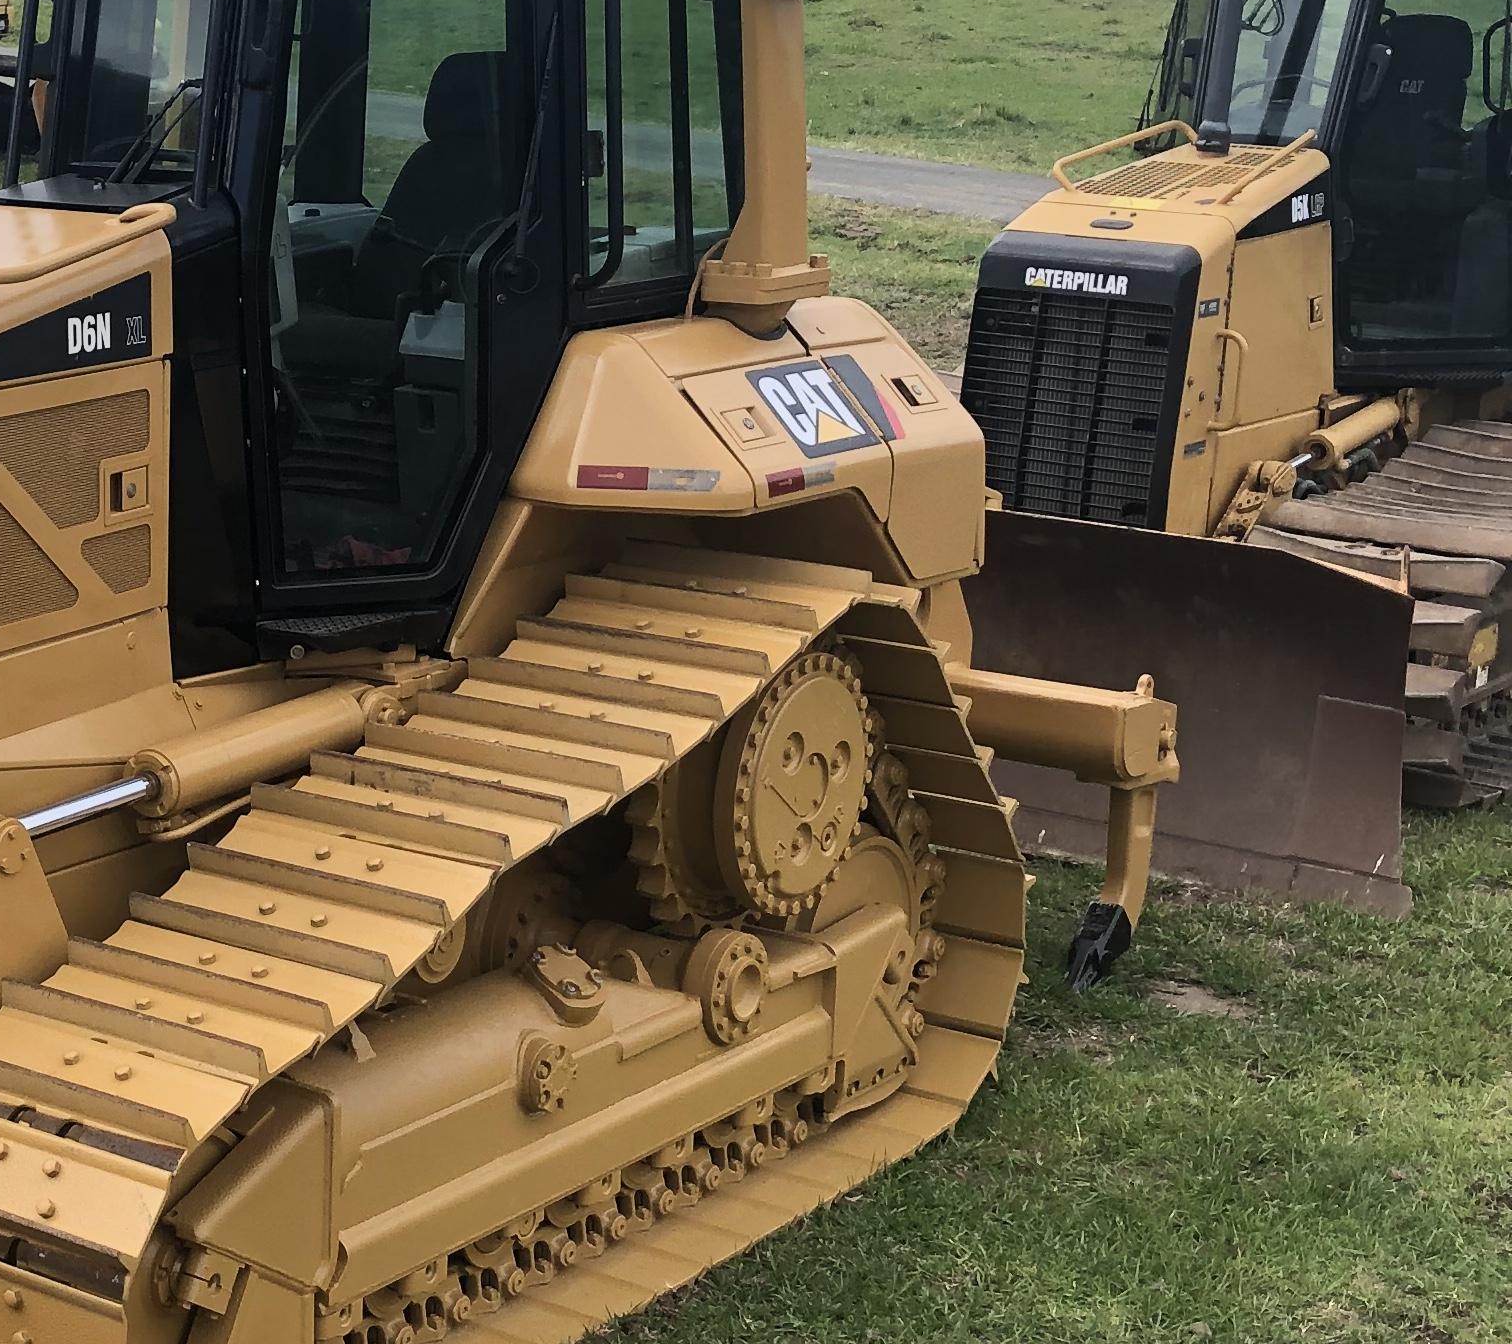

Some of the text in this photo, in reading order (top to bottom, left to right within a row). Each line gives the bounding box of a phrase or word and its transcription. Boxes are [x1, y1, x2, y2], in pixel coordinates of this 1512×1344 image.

[1400, 79, 1424, 93] CAT
[1291, 193, 1309, 223] D5K
[1025, 267, 1128, 296] CATERPILLAR
[68, 312, 147, 355] D6N XL
[758, 368, 866, 446] CAT
